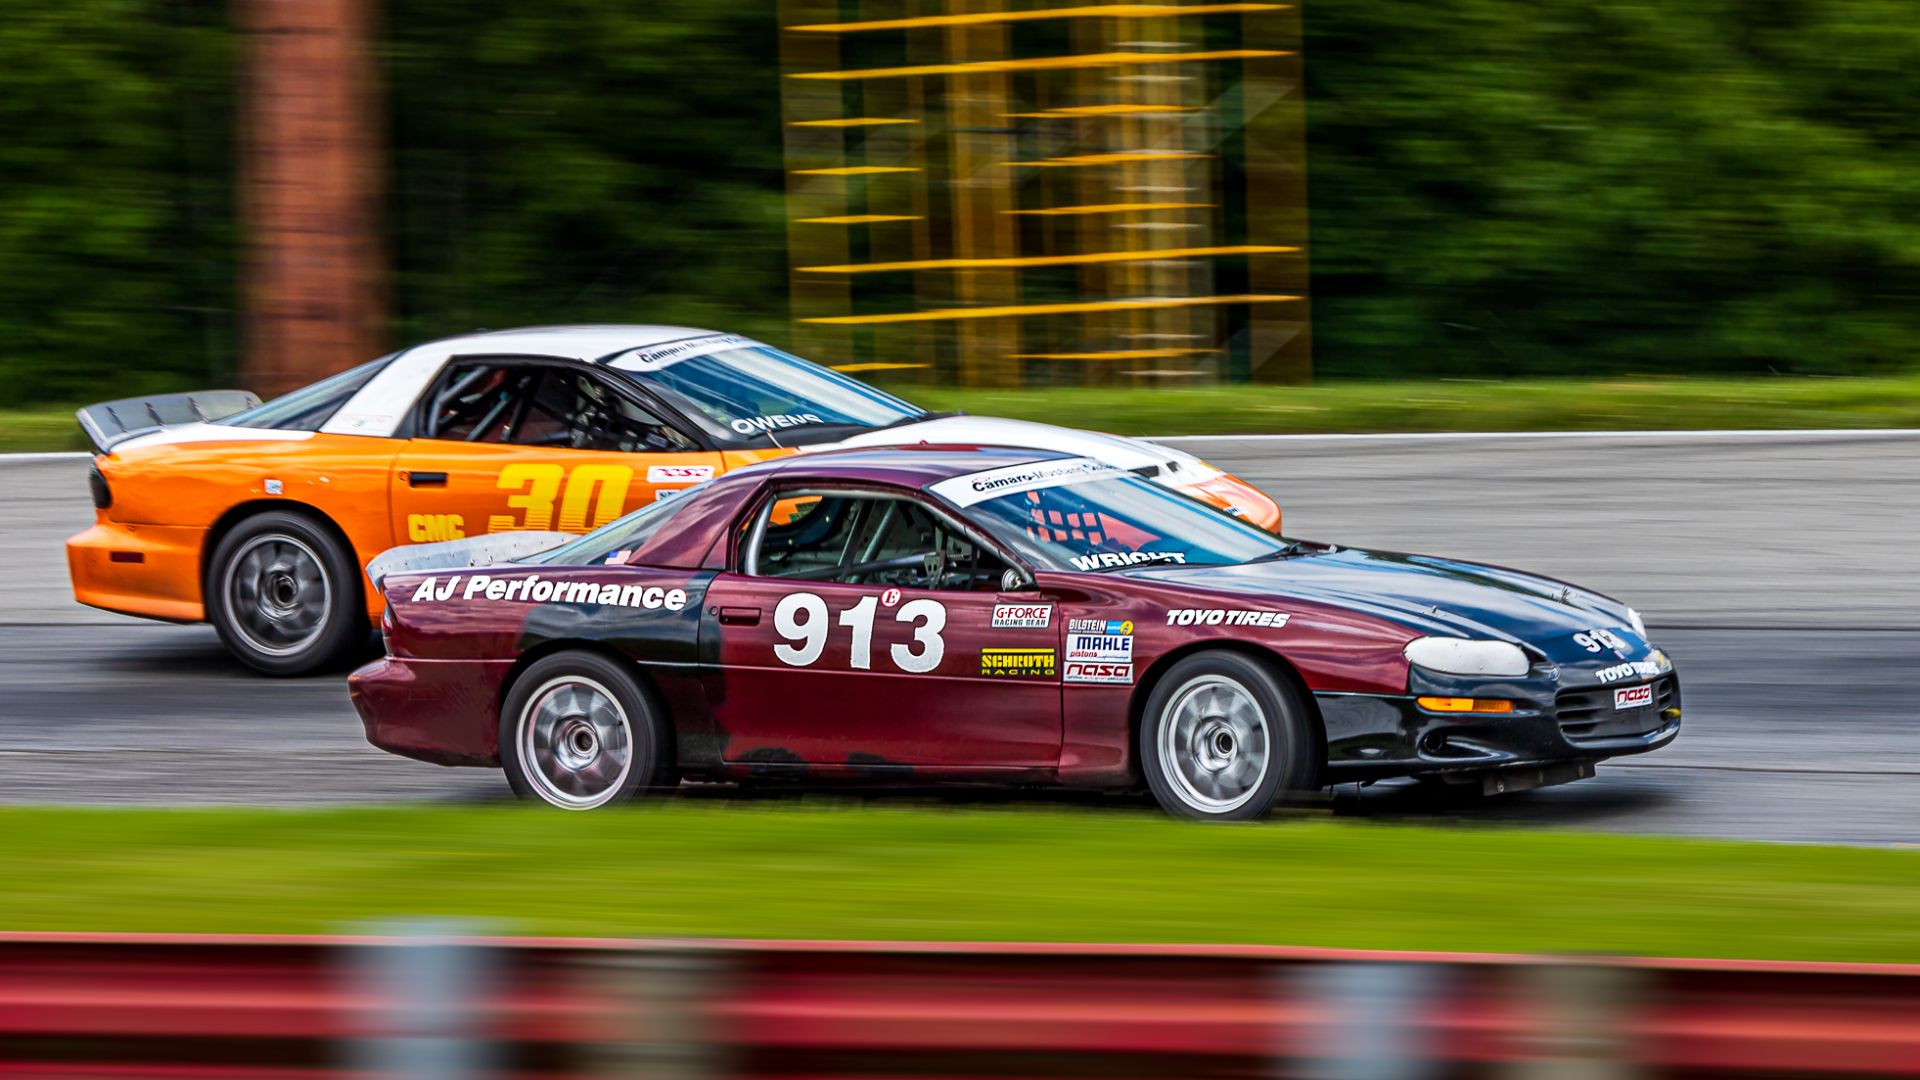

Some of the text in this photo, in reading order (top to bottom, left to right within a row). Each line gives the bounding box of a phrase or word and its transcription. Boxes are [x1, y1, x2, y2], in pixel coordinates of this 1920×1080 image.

[730, 413, 824, 434] OWENS
[487, 463, 634, 534] 30
[408, 514, 464, 541] CMC
[1069, 551, 1186, 571] WRIGHT
[411, 574, 687, 611] AJ Performance
[994, 618, 1023, 626] RACING
[1068, 618, 1107, 632] BILSTEIN
[773, 592, 947, 673] 913
[1076, 636, 1131, 651] MAHLE
[982, 654, 1055, 668] SCHROTH
[982, 668, 1055, 676] RACING
[1595, 663, 1634, 684] TOYO
